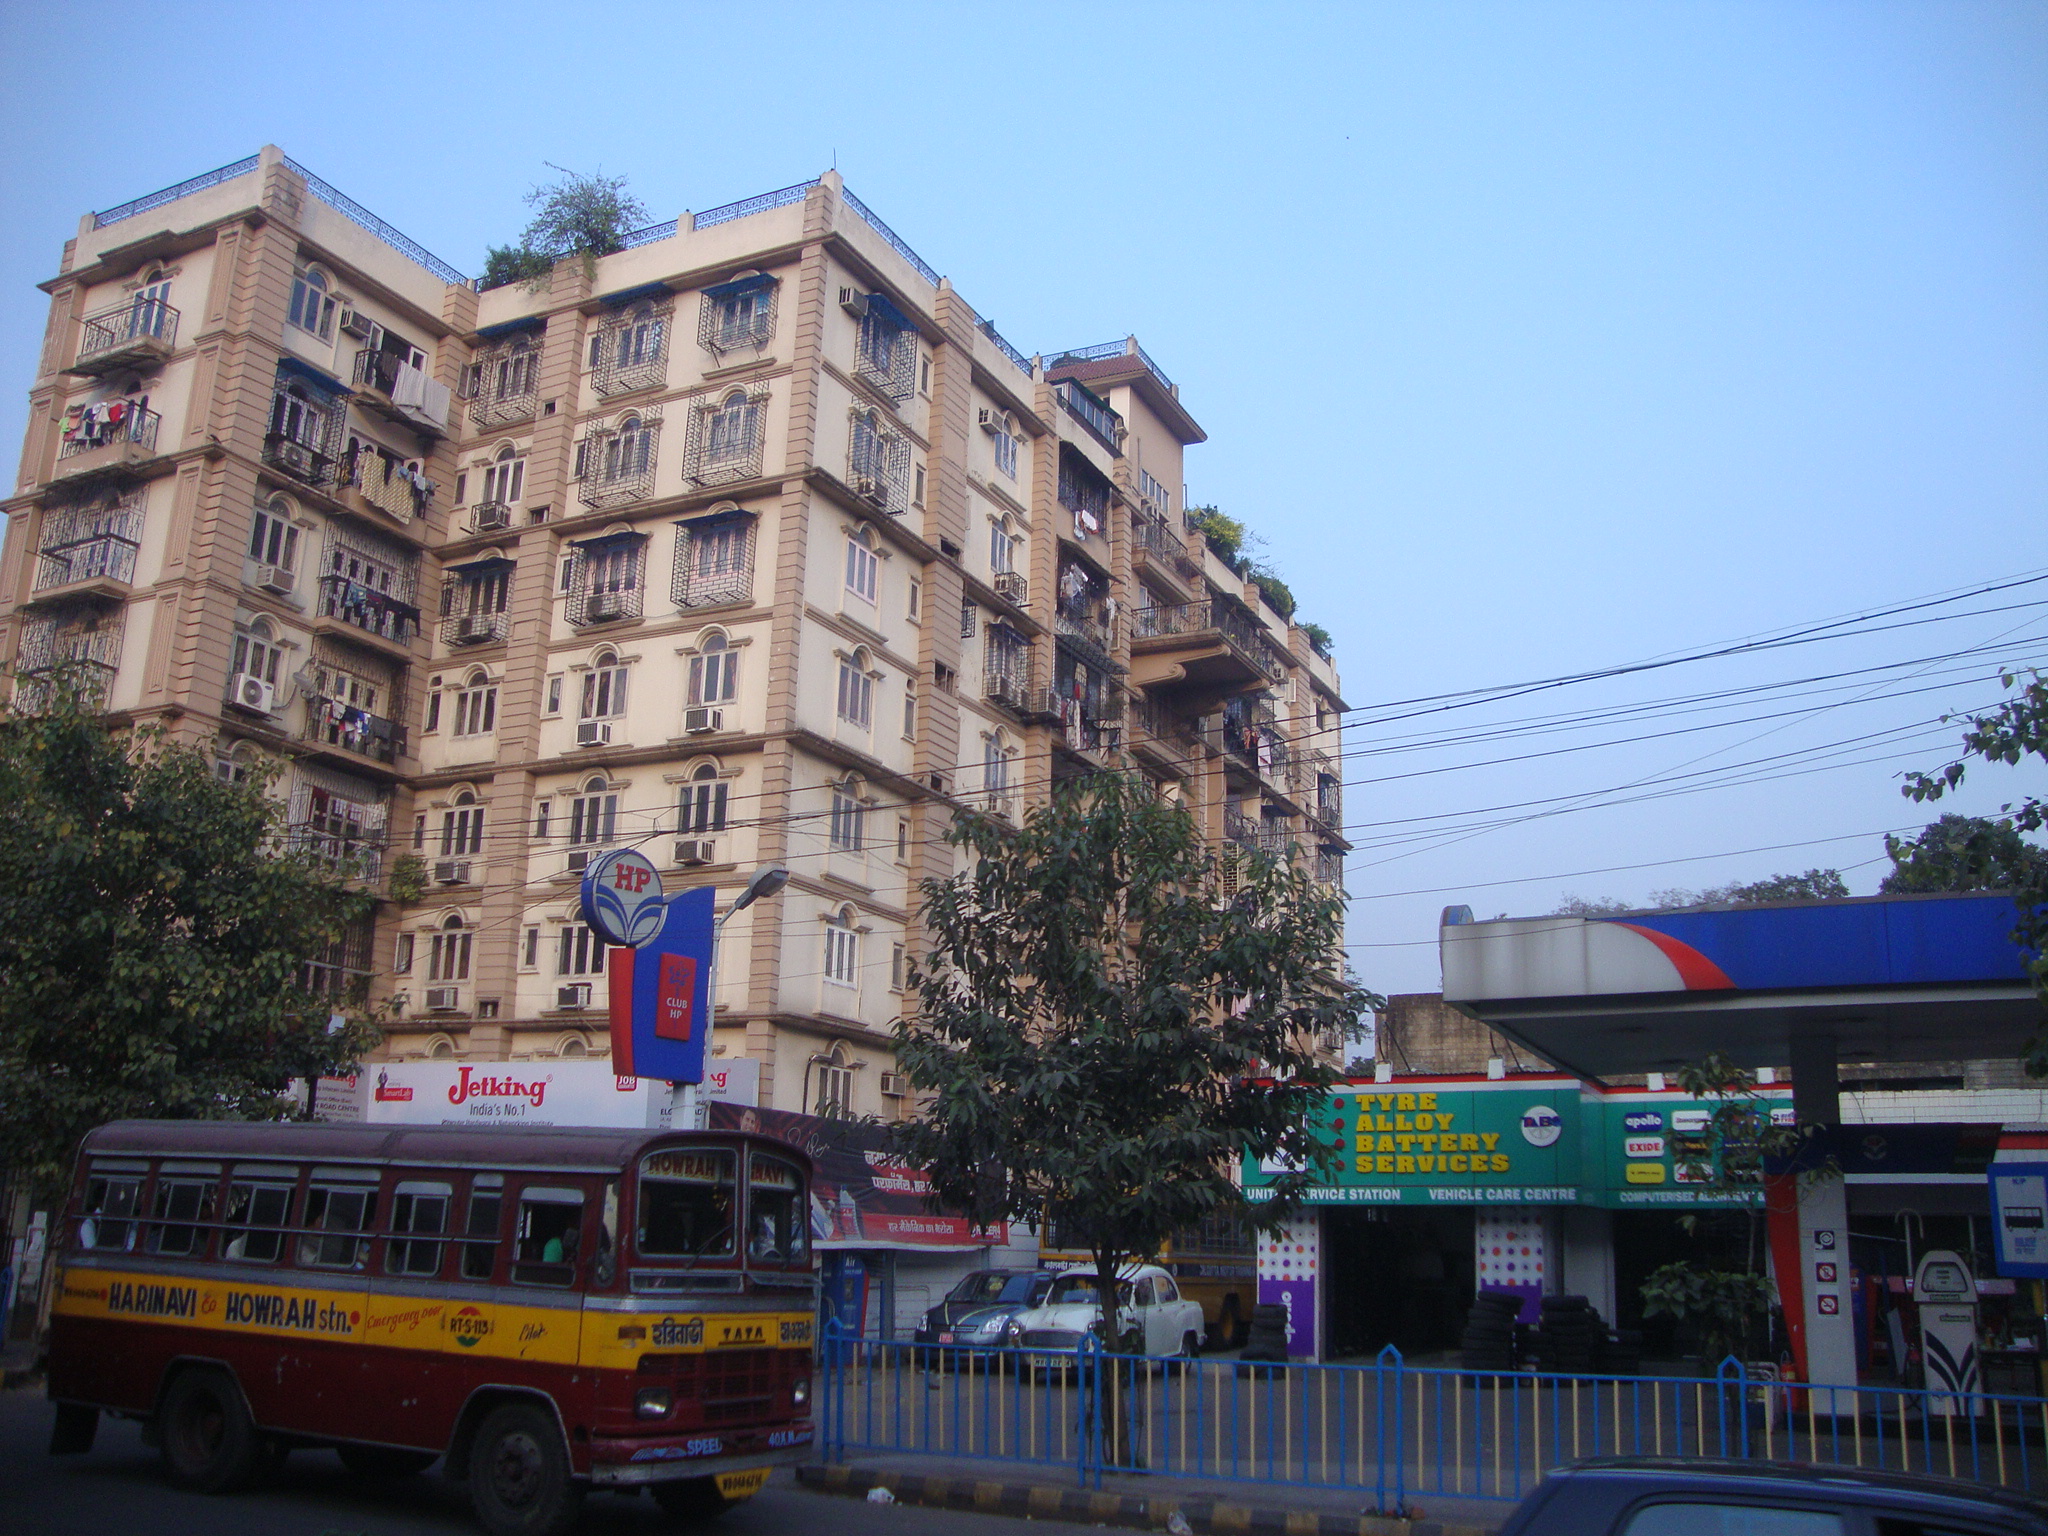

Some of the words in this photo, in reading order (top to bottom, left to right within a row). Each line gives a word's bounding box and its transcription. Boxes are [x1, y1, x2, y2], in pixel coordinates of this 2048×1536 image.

[614, 863, 651, 893] HP
[666, 998, 688, 1010] CLUB
[669, 1009, 683, 1019] HP
[448, 1066, 546, 1107] Jetking
[469, 1103, 501, 1116] India's
[504, 1103, 526, 1116] No.1
[1356, 1093, 1437, 1112] TYRE
[1355, 1113, 1455, 1132] ALLOY
[1625, 1114, 1662, 1129] apollo
[1355, 1133, 1501, 1153] BATTERY
[1629, 1143, 1661, 1152] EXIDE
[649, 1155, 717, 1181] HOWRAH
[1355, 1154, 1510, 1174] SERVICES
[1349, 1188, 1400, 1201] STATION
[1429, 1188, 1484, 1201] VEHICLE
[1486, 1188, 1522, 1201] CARE
[1525, 1188, 1576, 1201] CENTRE
[845, 1255, 856, 1267] Air
[108, 1282, 198, 1318] HARINAVI
[225, 1291, 317, 1330] HOWRAH
[723, 1326, 763, 1342] TATA
